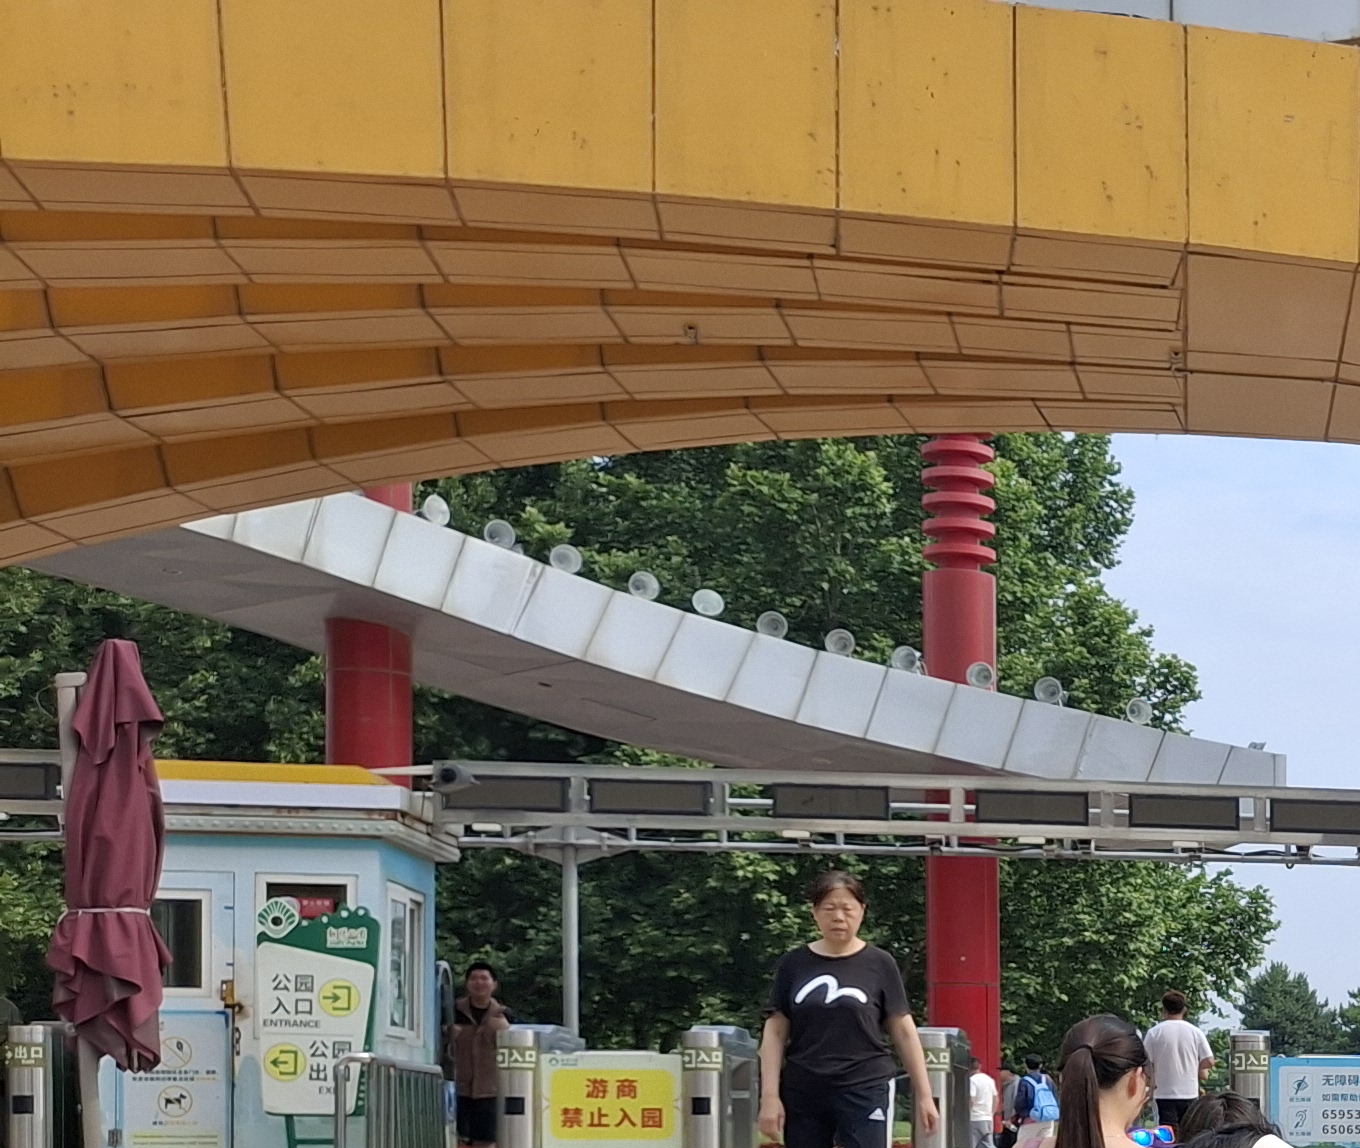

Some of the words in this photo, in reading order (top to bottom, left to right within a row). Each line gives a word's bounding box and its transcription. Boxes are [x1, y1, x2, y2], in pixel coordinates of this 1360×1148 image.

[271, 973, 315, 993] 公园
[271, 996, 313, 1016] 入口
[262, 1018, 321, 1029] ENTRANCE
[14, 1045, 43, 1059] 出口
[510, 1050, 537, 1062] 入口
[697, 1050, 723, 1063] 入口
[926, 1051, 949, 1063] 入口
[1246, 1053, 1269, 1066] 入口
[585, 1078, 639, 1099] 游商
[560, 1107, 664, 1129] 禁止入园
